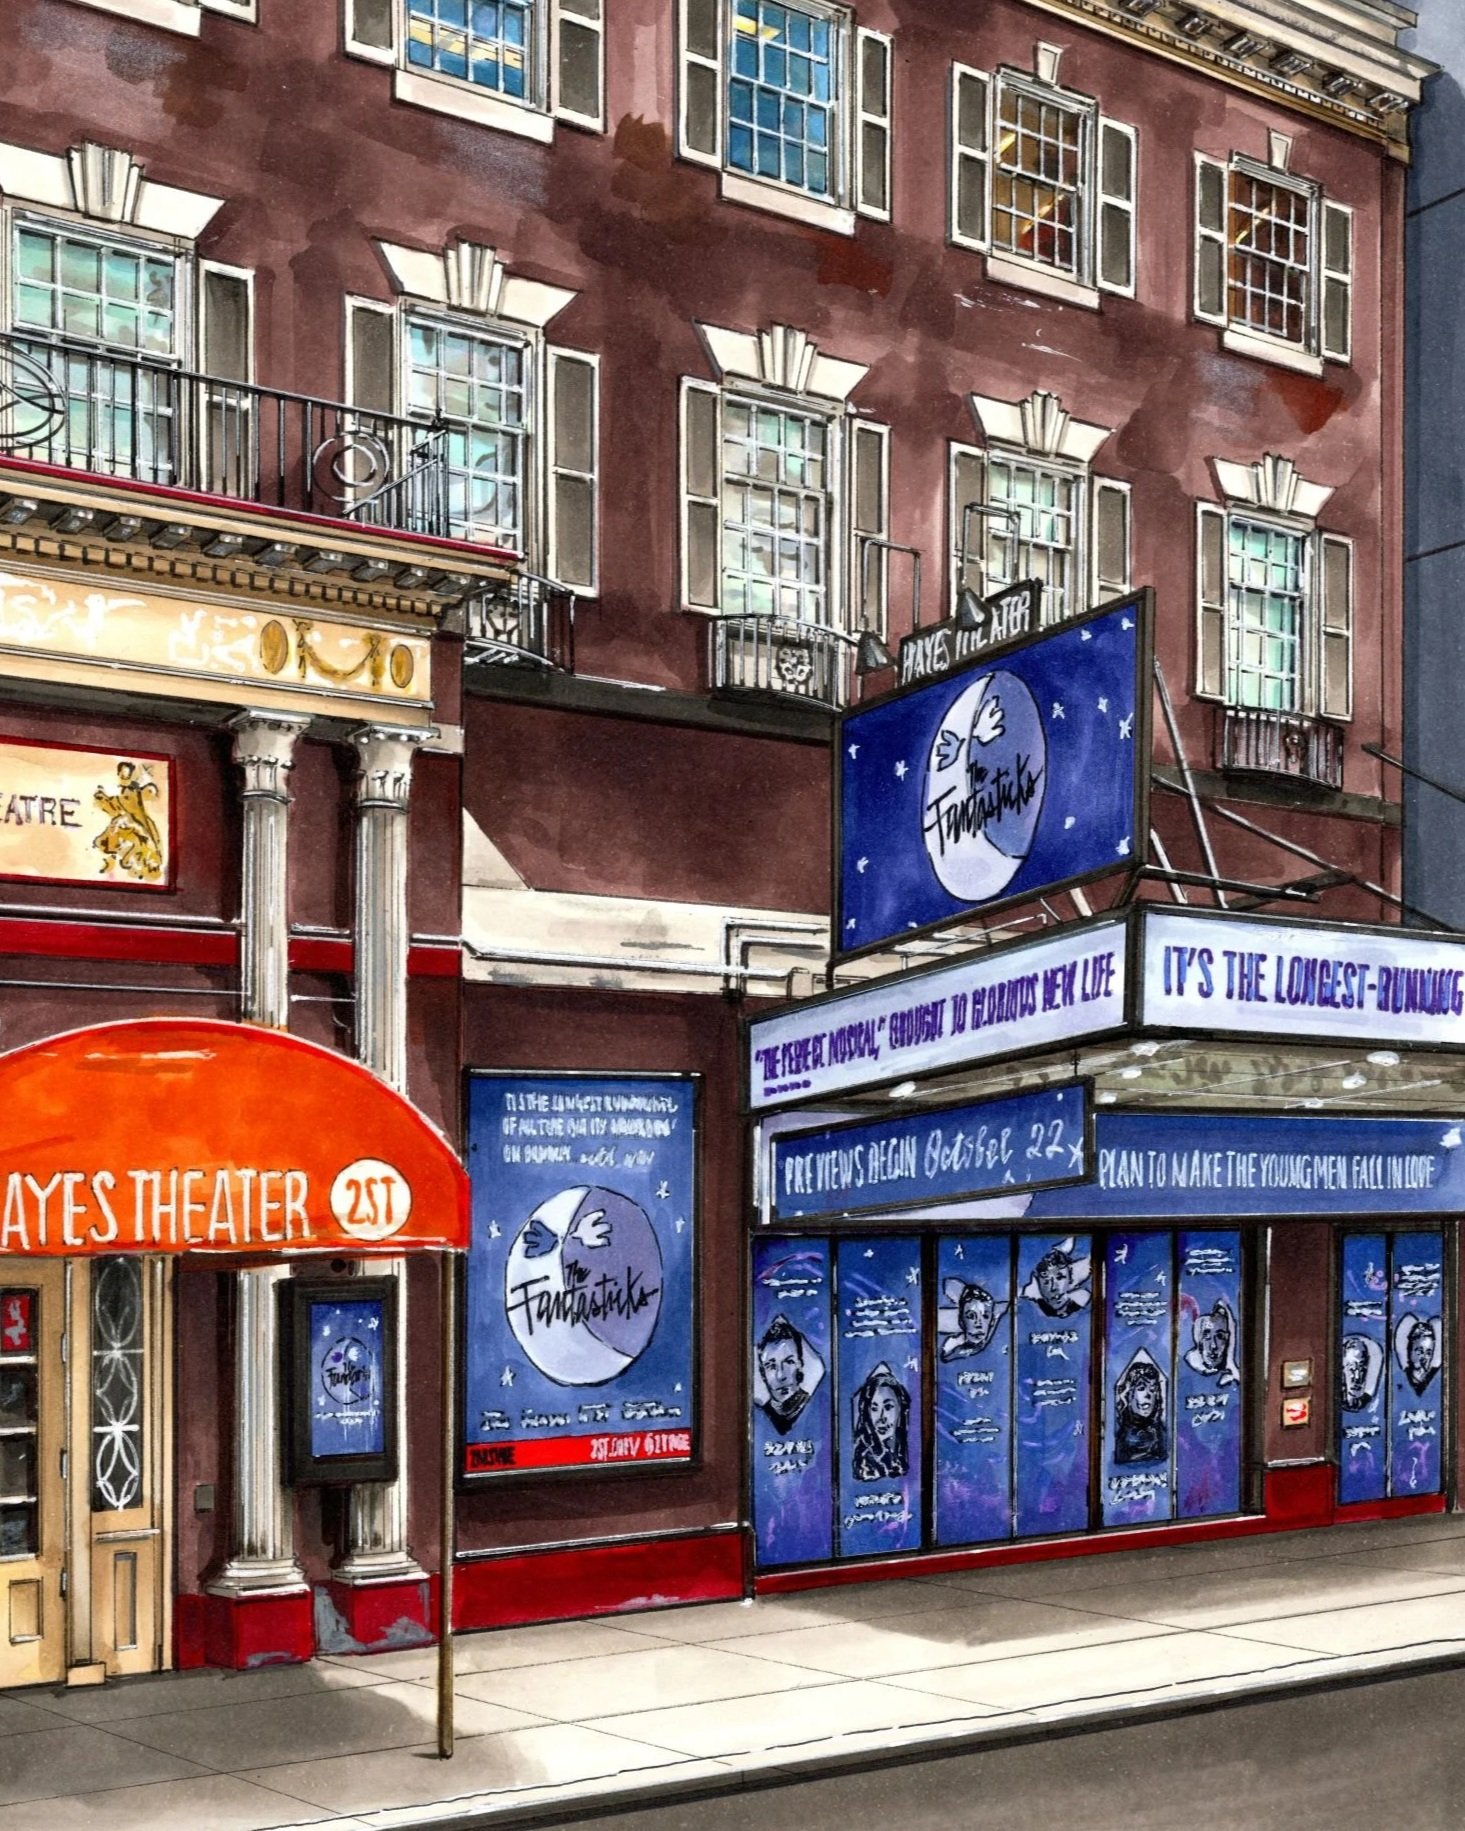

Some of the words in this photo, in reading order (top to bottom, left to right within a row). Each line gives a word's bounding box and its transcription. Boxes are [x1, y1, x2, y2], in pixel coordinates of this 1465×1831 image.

[902, 628, 952, 686] HAYES
[0, 793, 83, 828] ATRE
[950, 992, 968, 1036] TO
[1081, 951, 1116, 1002] LIFE
[1163, 945, 1214, 999] IT'S
[1222, 950, 1268, 1002] THE
[784, 1144, 865, 1195] PREVIEWS
[867, 1135, 917, 1184] BEGIN
[1026, 1118, 1064, 1160] 22
[1100, 1148, 1143, 1190] PLAN
[1147, 1151, 1167, 1189] TO
[1226, 1150, 1258, 1188] THE
[1260, 1153, 1312, 1189] YOUNG
[1313, 1155, 1348, 1189] MEN
[1352, 1155, 1384, 1190] FALL
[1387, 1156, 1403, 1190] IN
[1404, 1155, 1436, 1190] LOVE
[1, 1170, 118, 1250] AYES
[127, 1168, 312, 1245] THEATER
[346, 1175, 397, 1227] 2ST
